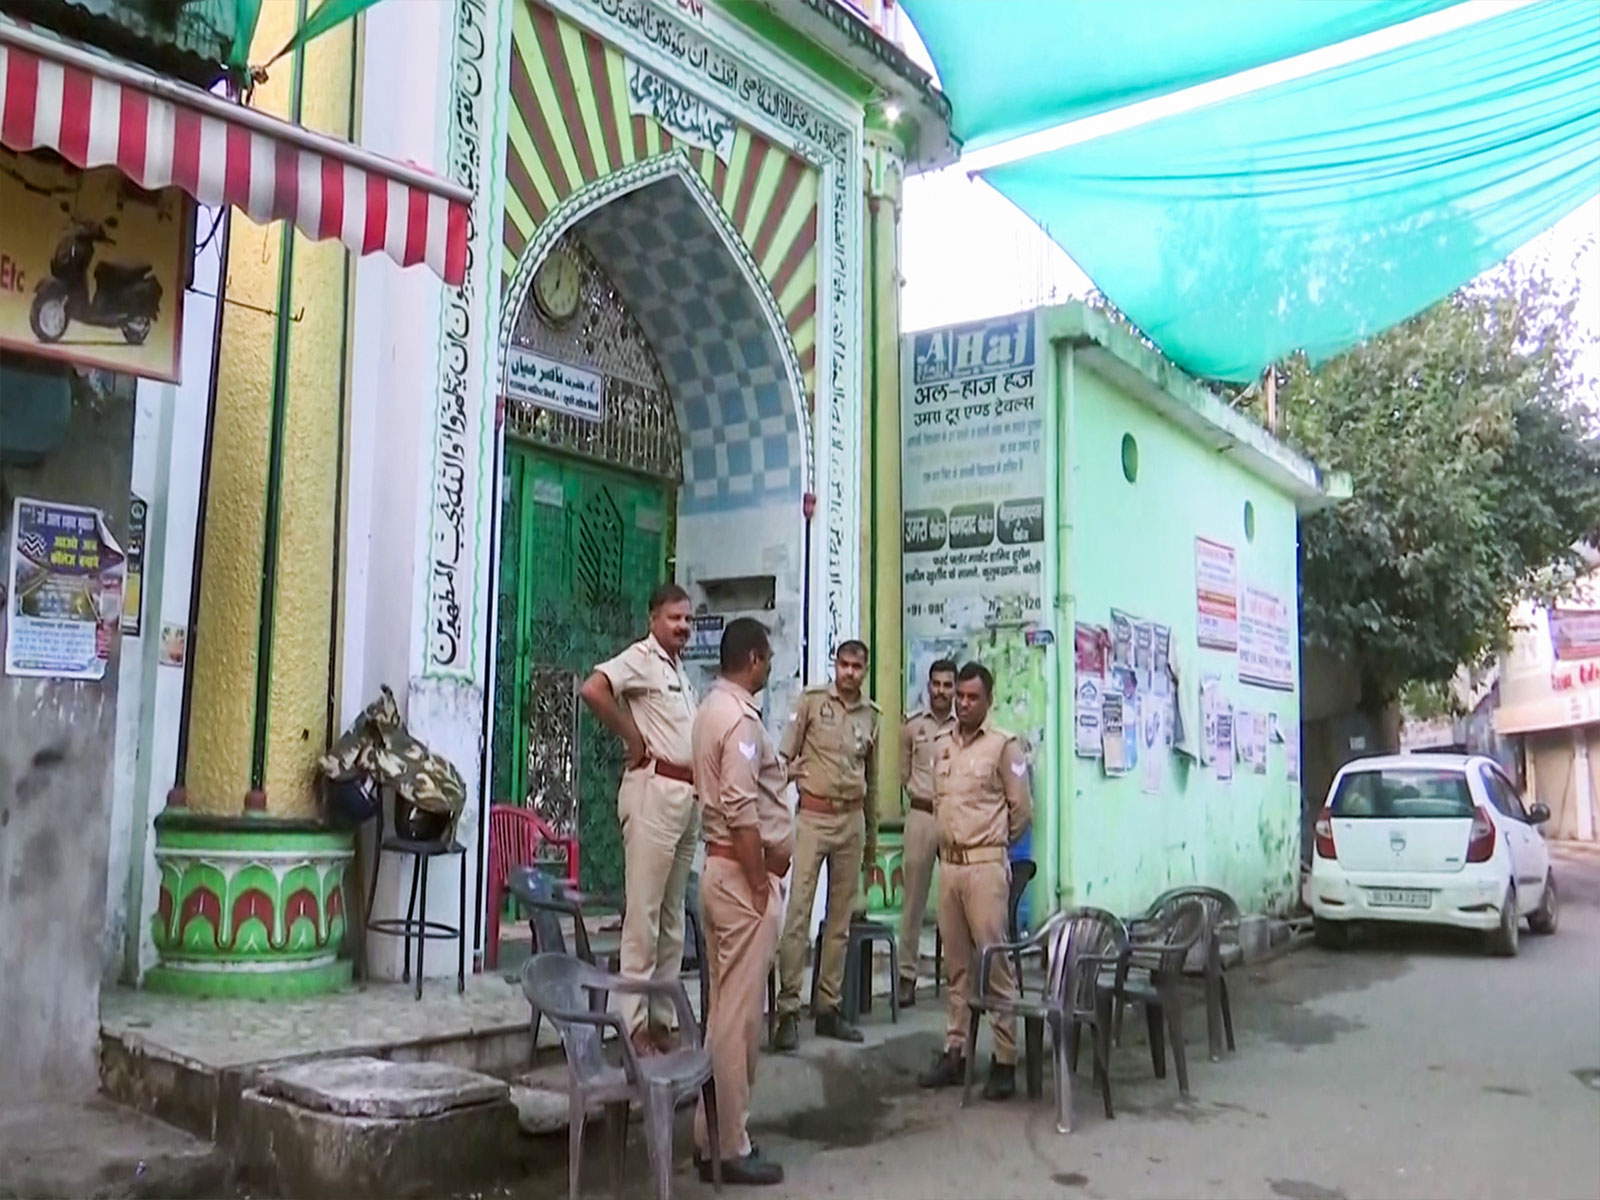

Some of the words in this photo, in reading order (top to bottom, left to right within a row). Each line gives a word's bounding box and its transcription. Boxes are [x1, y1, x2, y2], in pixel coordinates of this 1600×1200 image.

[914, 375, 997, 406] अल-हाज
[1002, 369, 1034, 393] हज
[913, 410, 942, 428] उमरा
